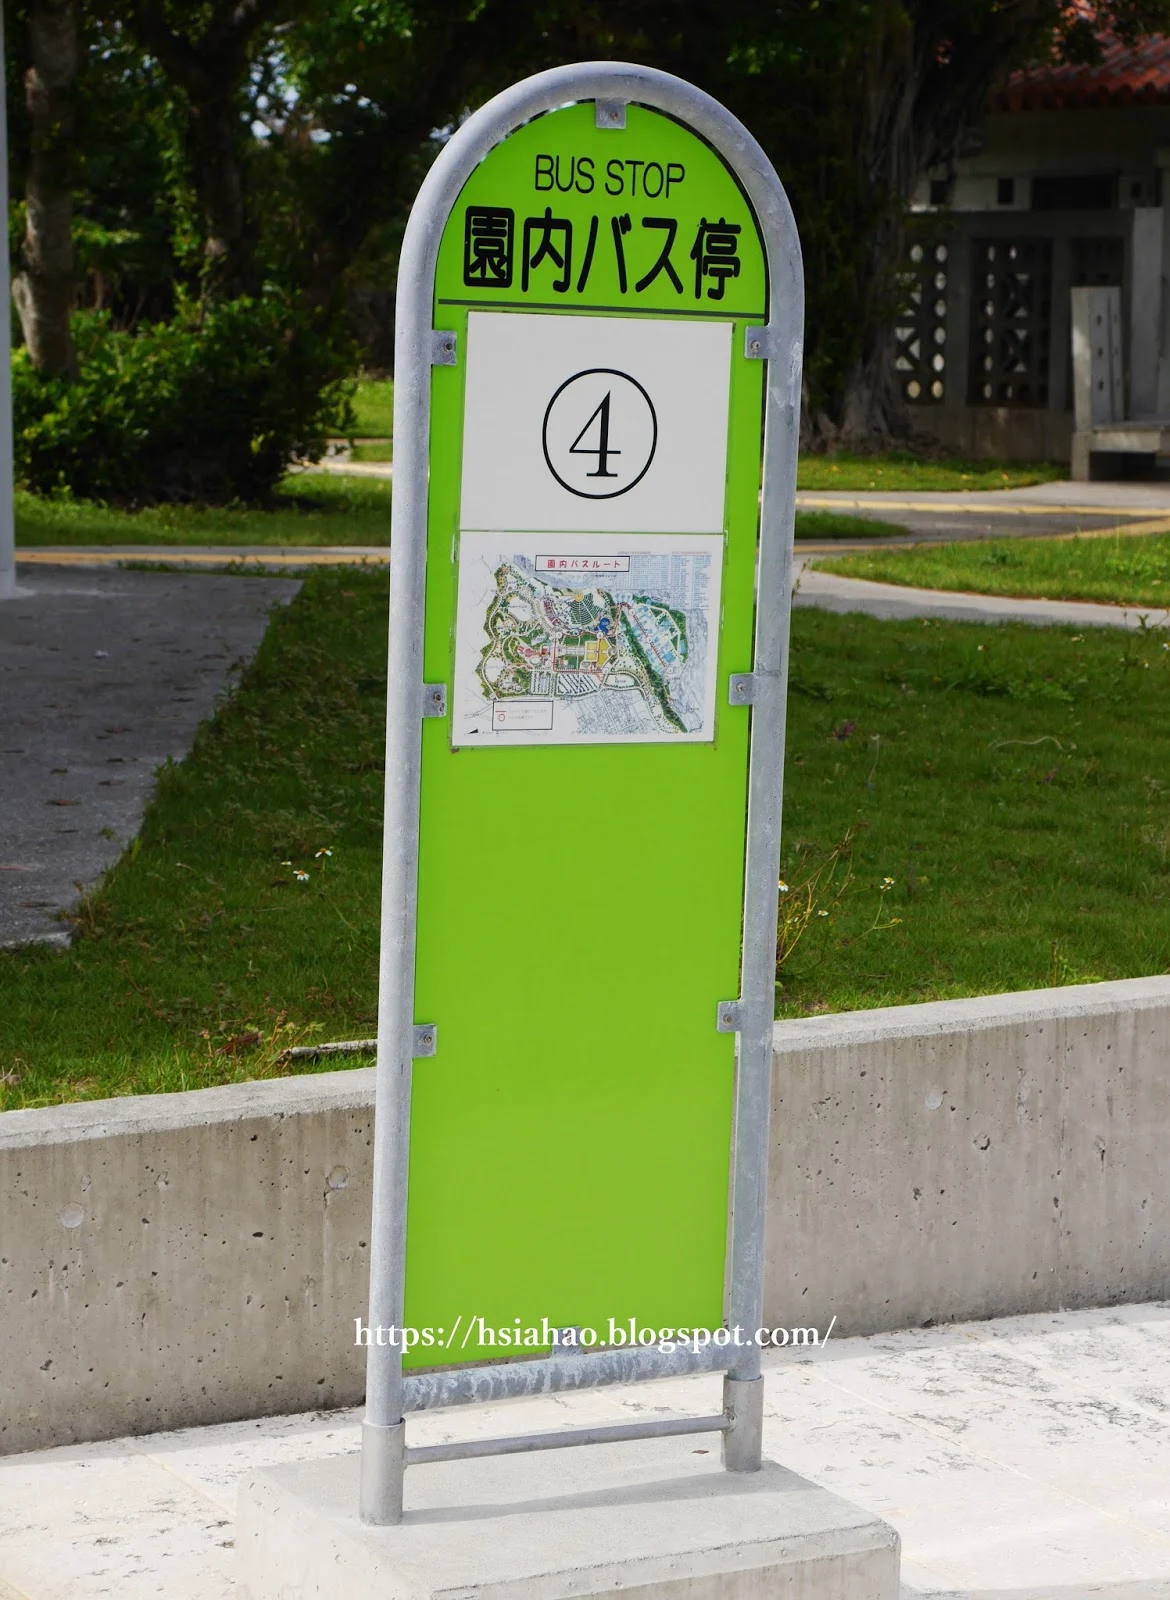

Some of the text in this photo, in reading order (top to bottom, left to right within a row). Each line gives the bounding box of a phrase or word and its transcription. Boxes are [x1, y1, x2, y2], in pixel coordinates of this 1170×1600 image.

[534, 154, 685, 199] BUS STOP
[463, 206, 742, 300] 園内バス停
[569, 389, 621, 477] 4
[547, 559, 620, 569] 園内バスルート
